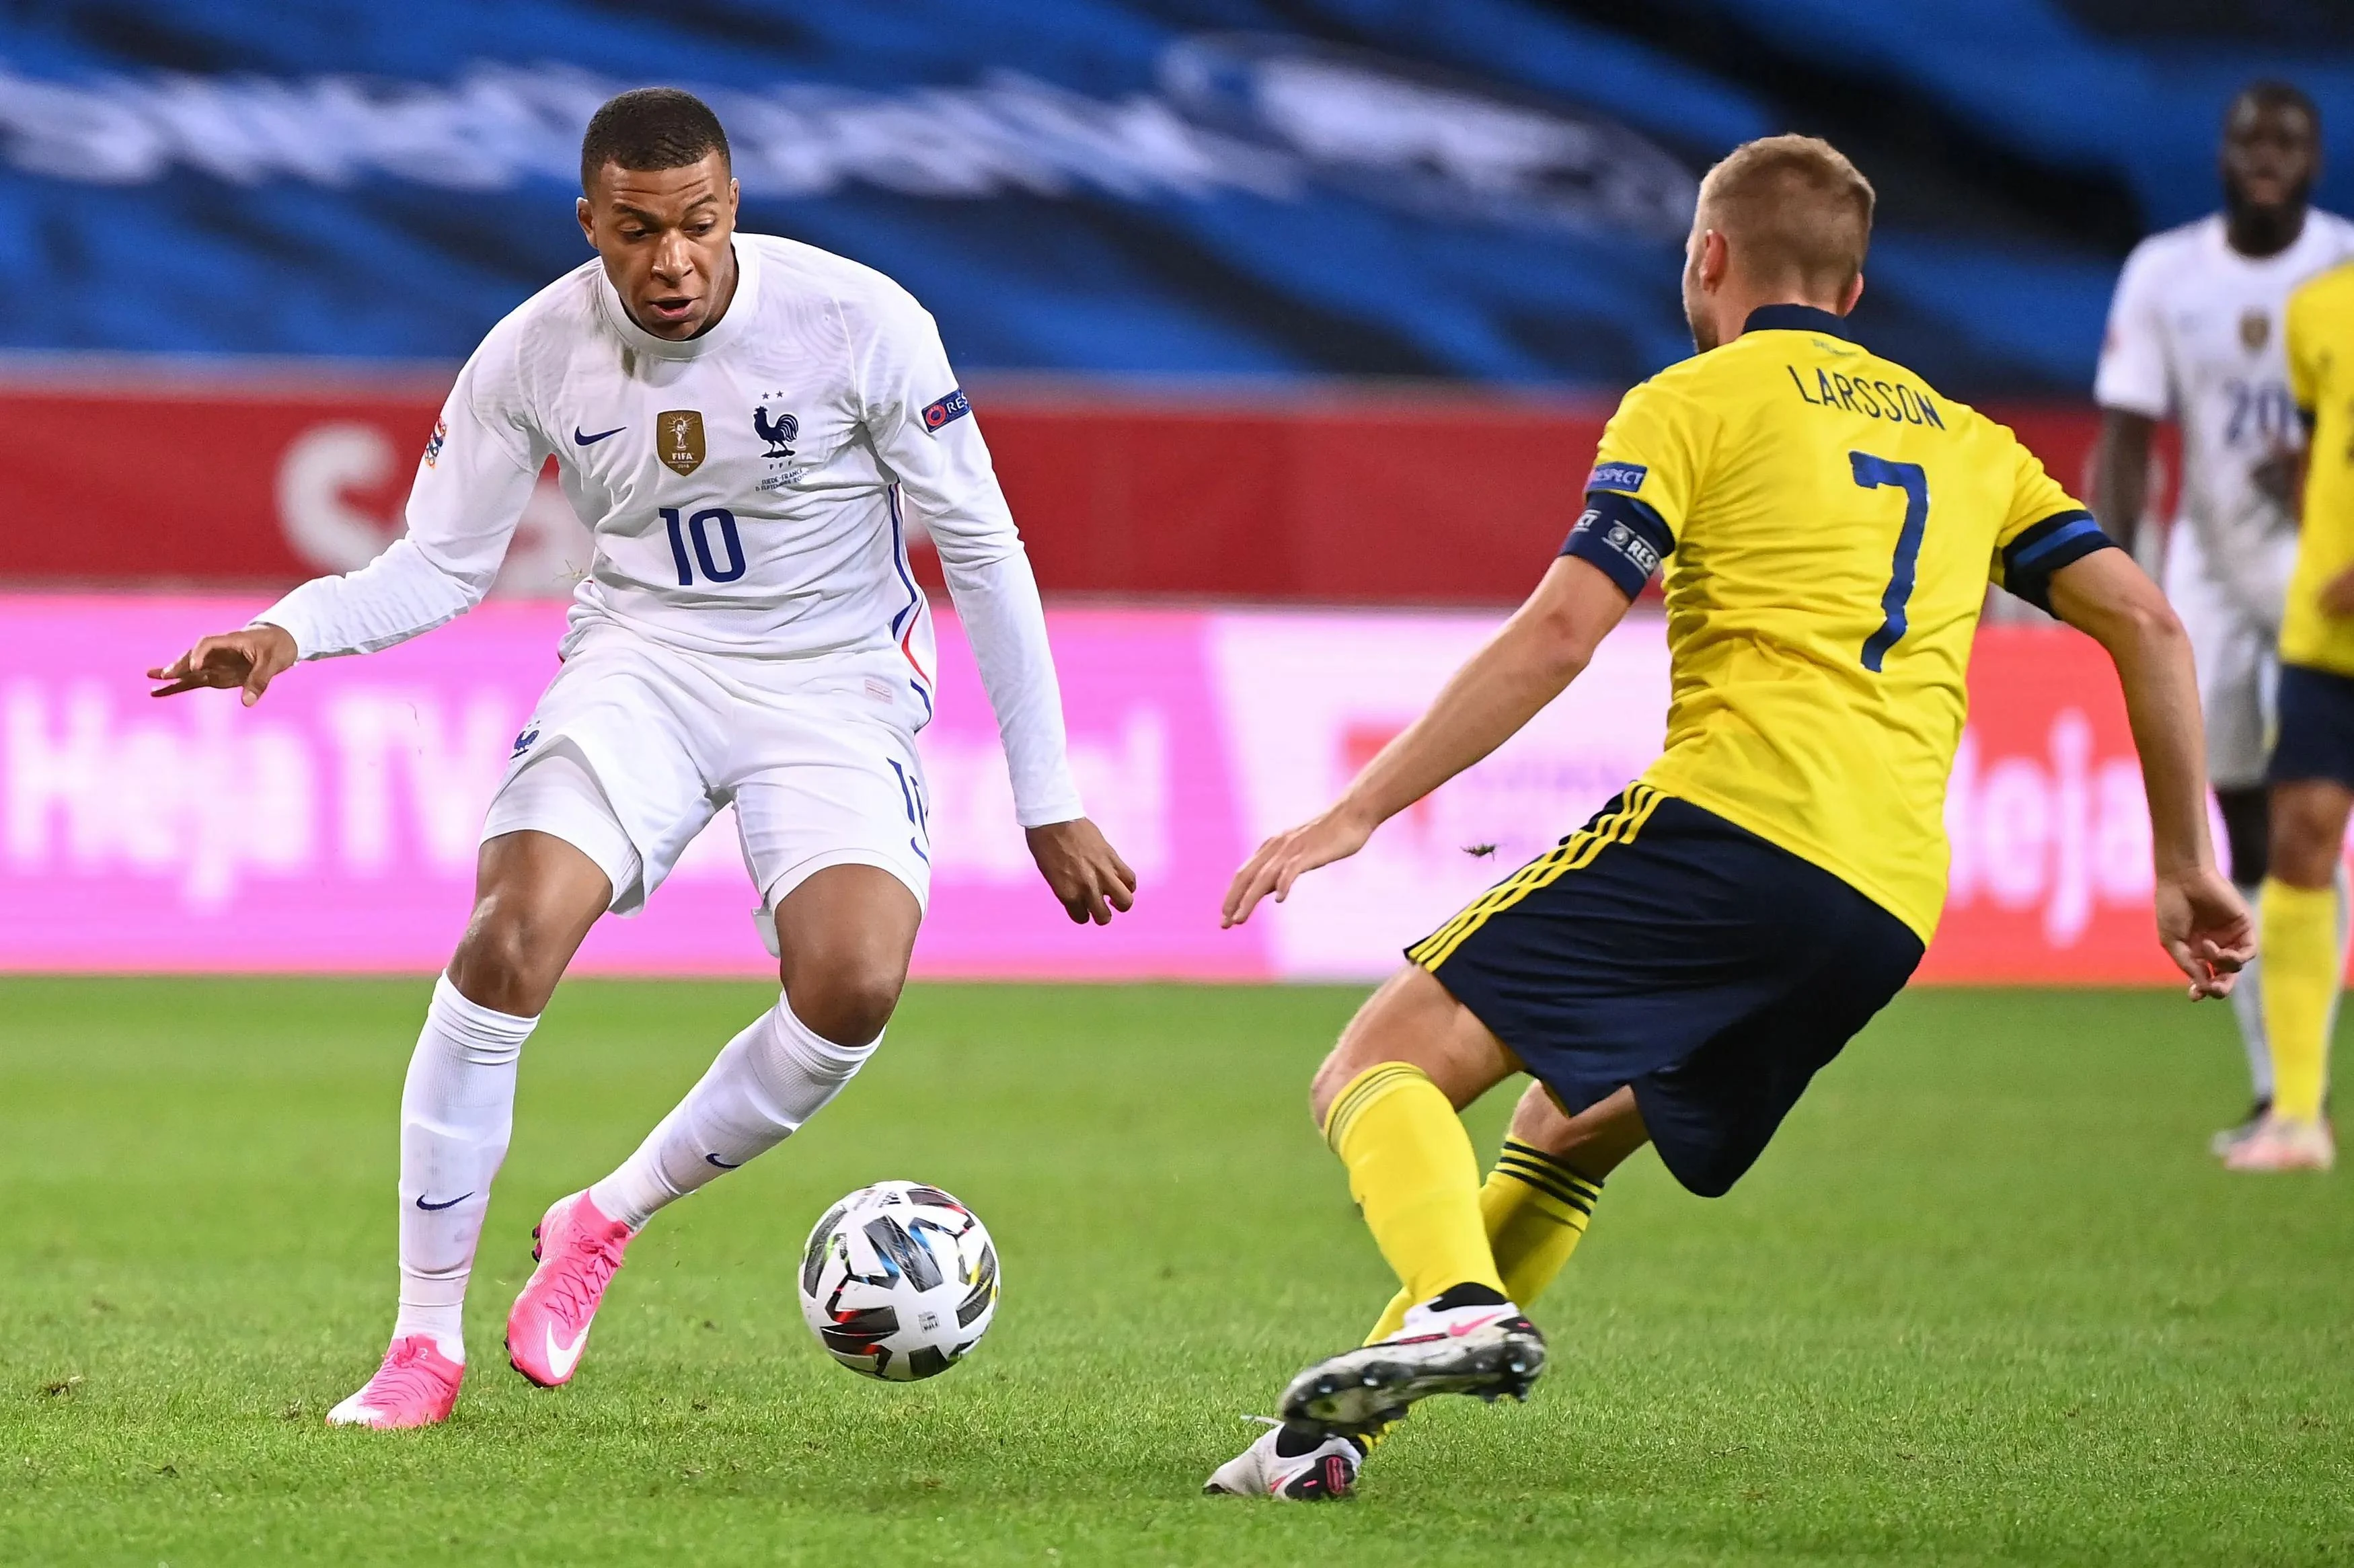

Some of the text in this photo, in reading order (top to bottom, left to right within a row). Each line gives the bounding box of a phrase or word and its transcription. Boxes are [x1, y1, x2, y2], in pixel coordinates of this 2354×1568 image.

[1787, 365, 1946, 430] LARSSON
[672, 453, 693, 461] FIFA
[659, 508, 747, 586] 10
[1848, 451, 1930, 673] 7
